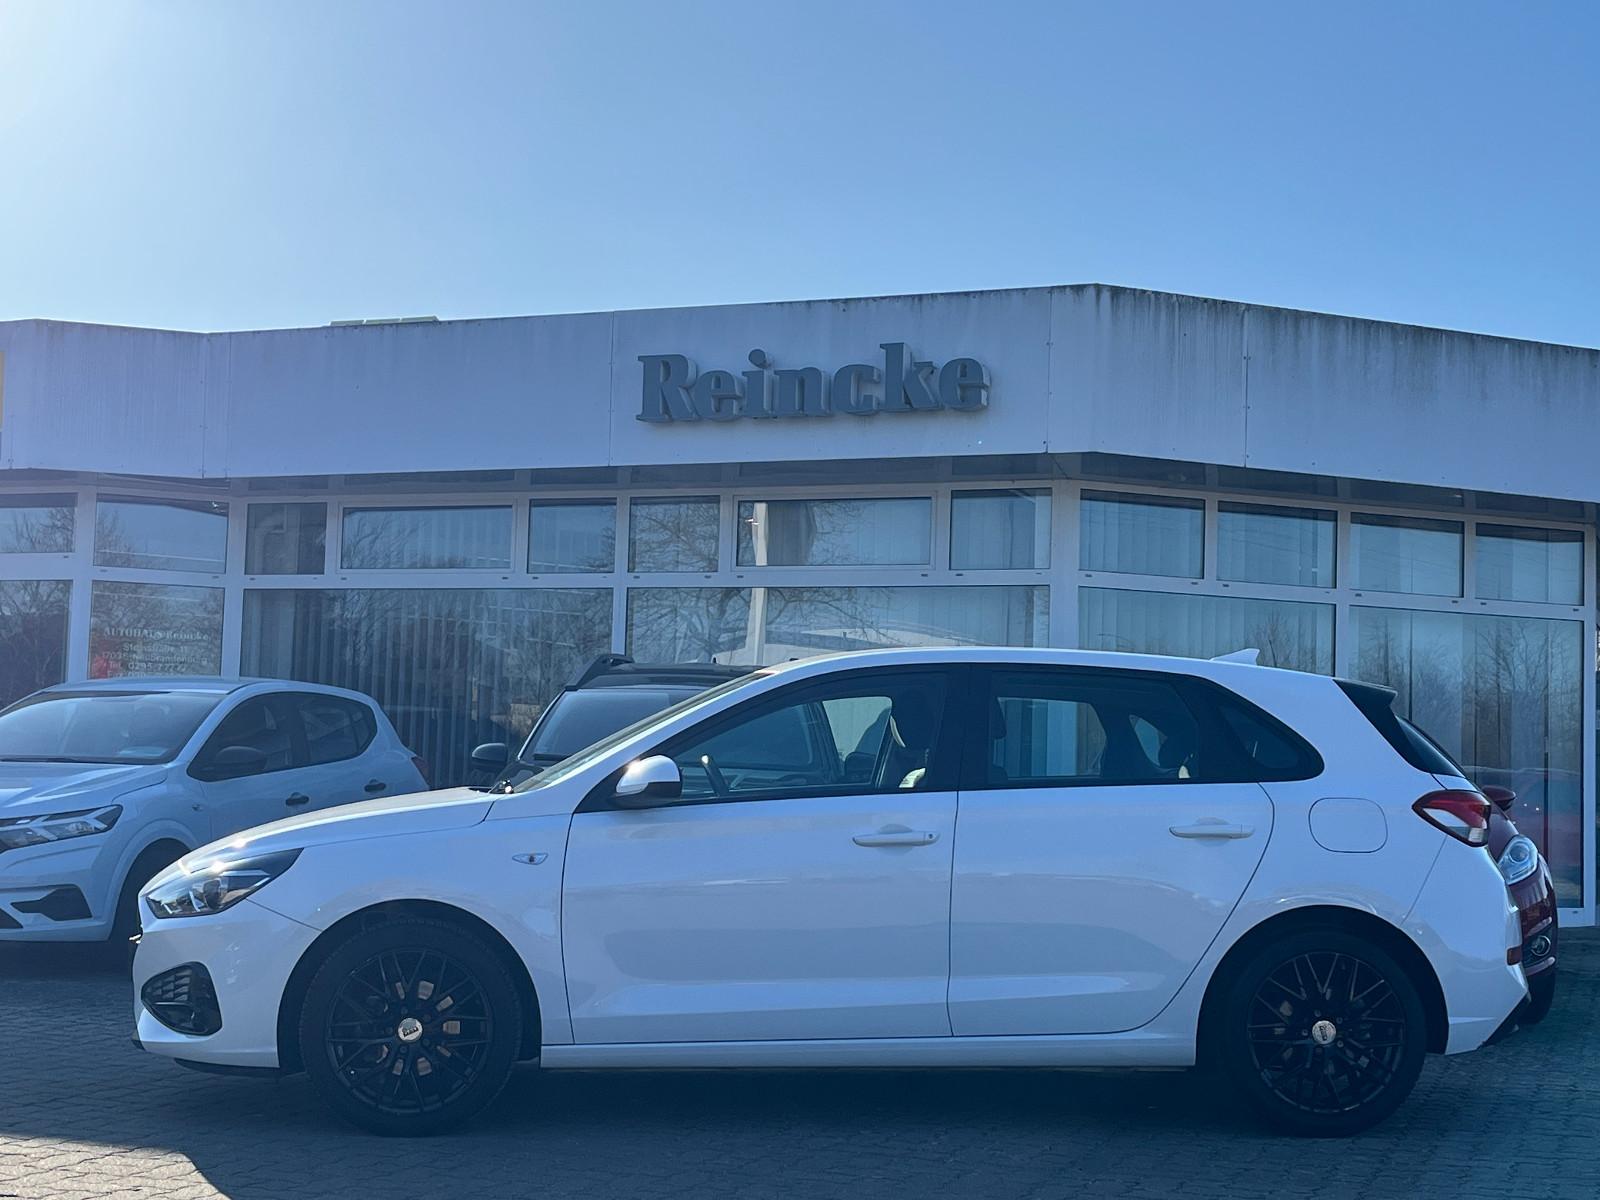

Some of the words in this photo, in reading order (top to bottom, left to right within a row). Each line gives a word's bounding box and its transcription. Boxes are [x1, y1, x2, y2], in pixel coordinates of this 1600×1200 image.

[636, 342, 990, 422] Reincke
[103, 627, 163, 640] AUTOHAUS
[166, 630, 209, 641] Reincke
